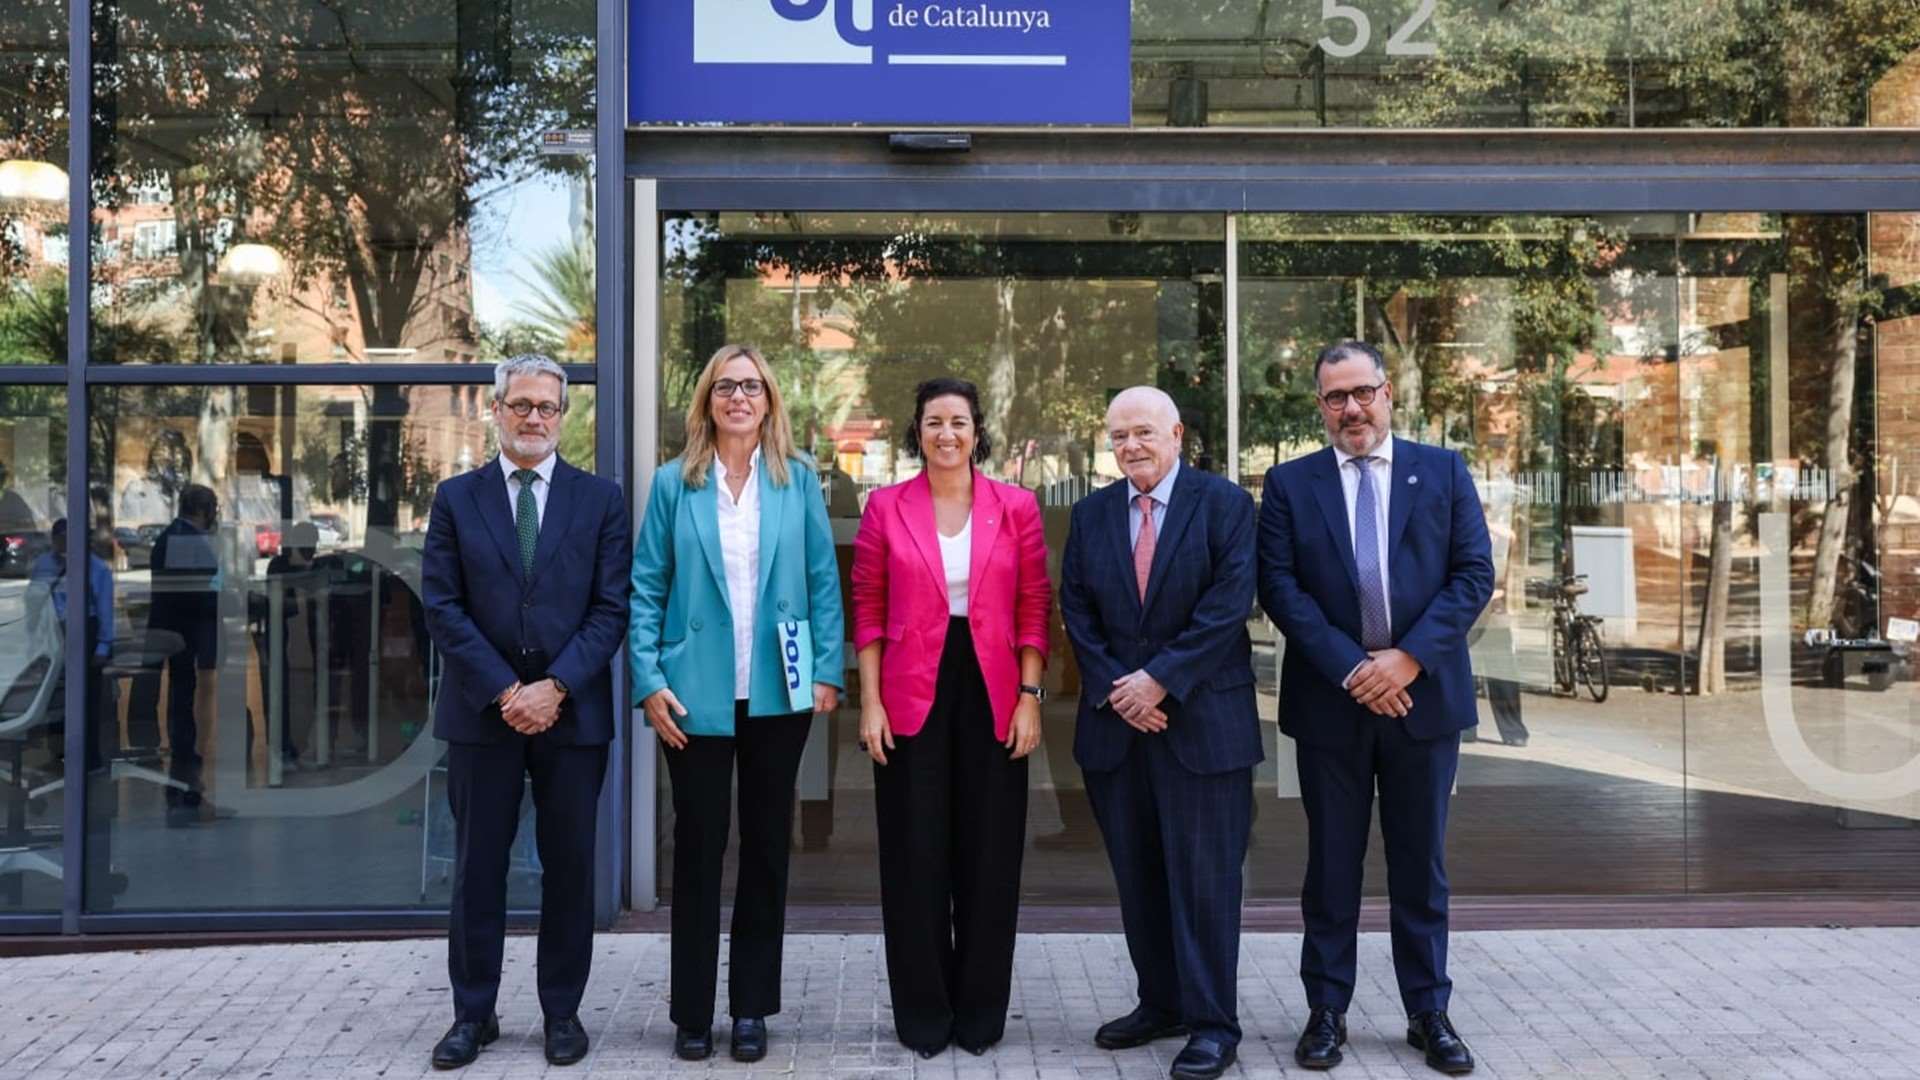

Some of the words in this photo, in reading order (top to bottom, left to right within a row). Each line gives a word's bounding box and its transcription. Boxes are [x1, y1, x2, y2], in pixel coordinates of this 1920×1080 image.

[888, 4, 919, 27] de
[924, 4, 1051, 33] Catalunya
[1318, 0, 1438, 57] 52
